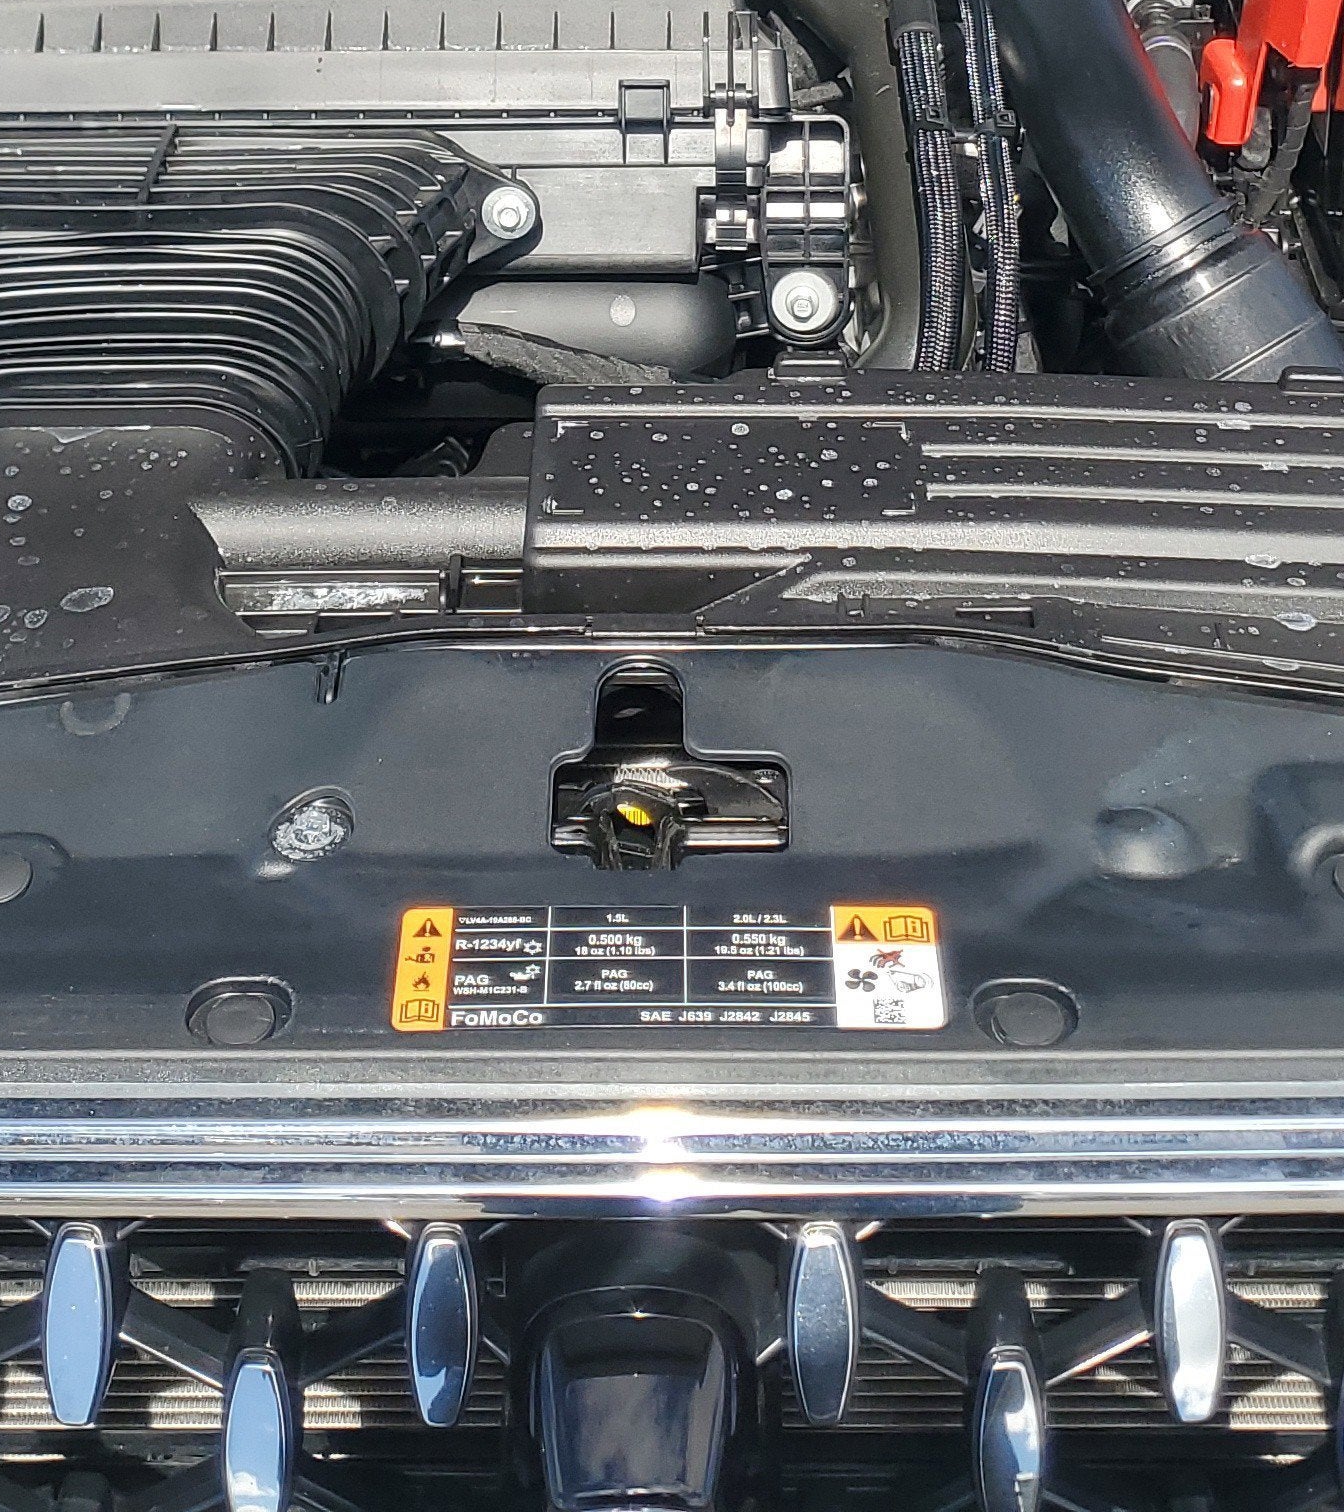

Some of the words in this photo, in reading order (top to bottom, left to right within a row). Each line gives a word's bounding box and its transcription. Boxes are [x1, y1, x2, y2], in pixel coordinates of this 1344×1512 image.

[733, 914, 756, 924] 2.0L
[763, 914, 788, 924] 2.3L
[455, 938, 522, 952] R-1234yf
[588, 934, 623, 946] 0.500
[625, 933, 642, 947] kg
[731, 933, 766, 945] 0.550
[769, 933, 786, 947] kg
[590, 947, 605, 956] oz
[606, 946, 632, 956] (1.10
[634, 945, 656, 956] lbs)
[739, 947, 753, 955] oz
[755, 945, 780, 956] (1.21
[783, 946, 805, 956] lbs)
[601, 969, 629, 979] PAG
[747, 970, 774, 980] PAG
[454, 974, 490, 986] PAG
[574, 980, 592, 991] 2.7
[594, 980, 601, 991] fl
[603, 982, 618, 990] oz
[717, 981, 735, 991] 3.4
[737, 980, 744, 991] fl
[746, 983, 761, 991] oz
[762, 981, 803, 993] (100cc)
[450, 1009, 543, 1026] FoMoCo
[640, 1011, 672, 1022] SAE
[678, 1011, 712, 1022] J639
[719, 1011, 760, 1022] J2842
[769, 1011, 811, 1022] J2845
